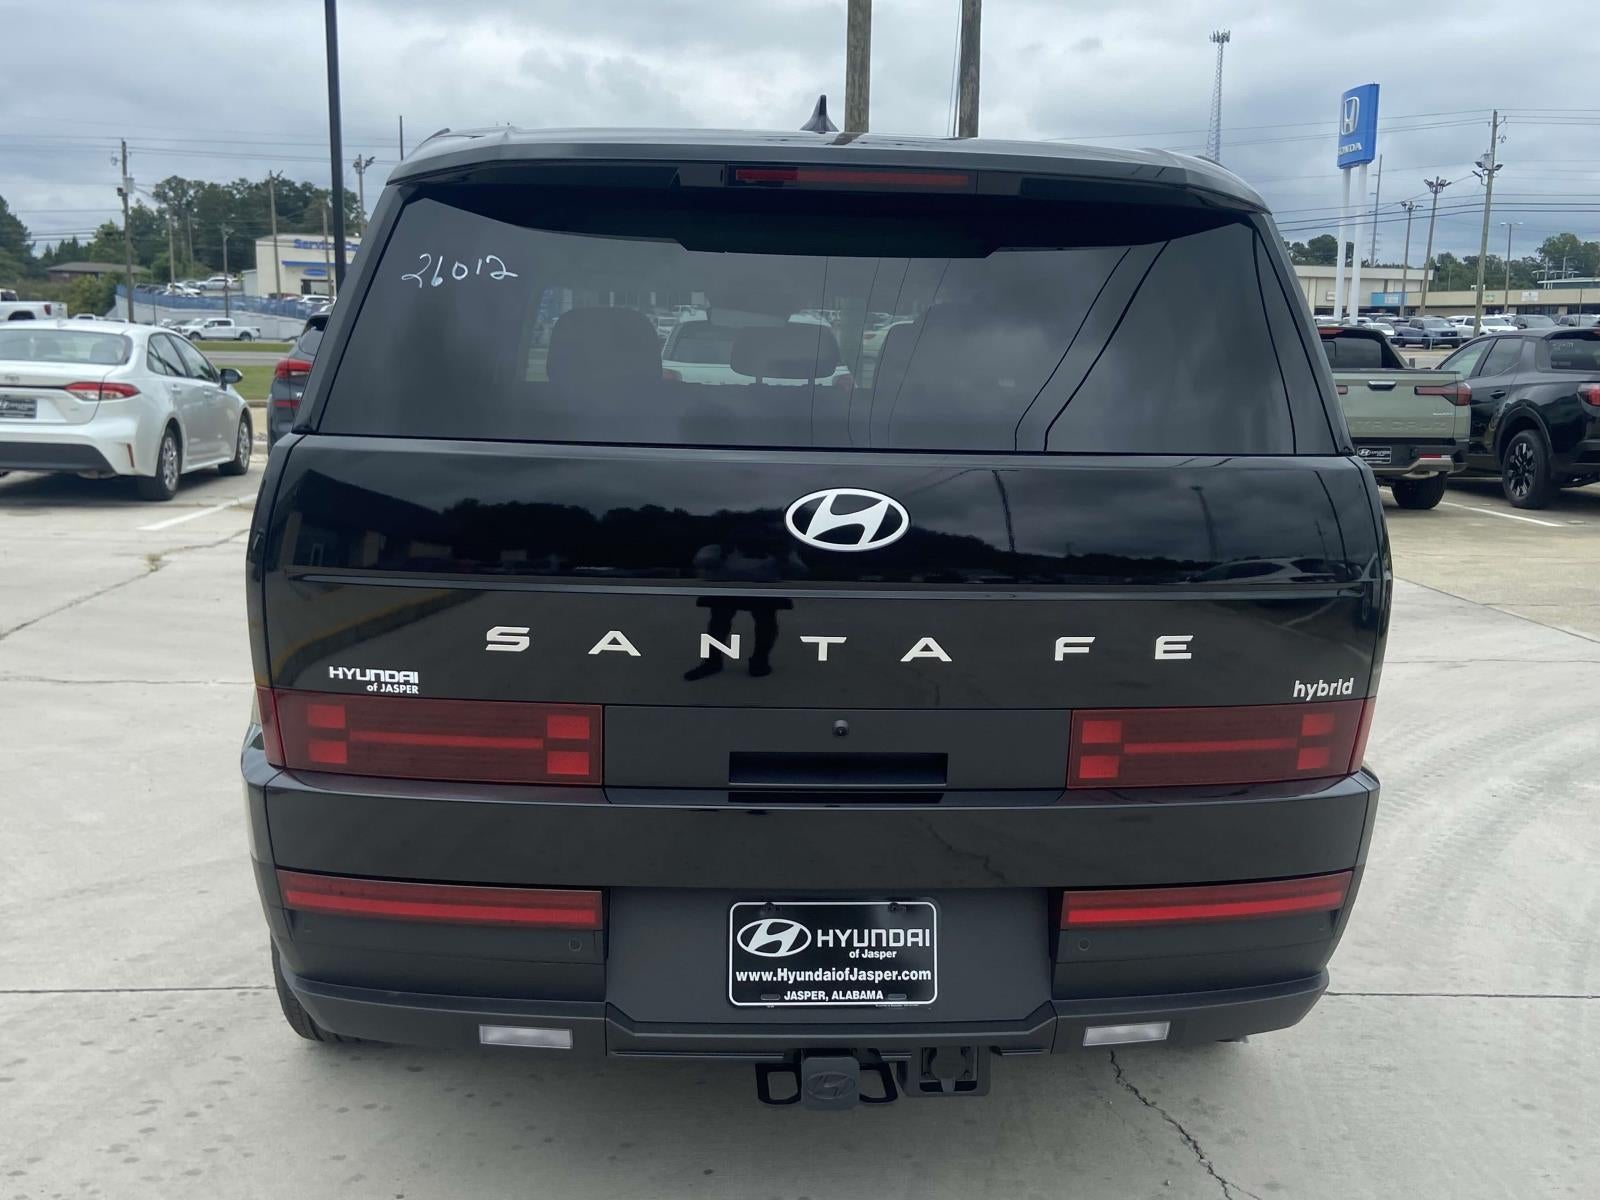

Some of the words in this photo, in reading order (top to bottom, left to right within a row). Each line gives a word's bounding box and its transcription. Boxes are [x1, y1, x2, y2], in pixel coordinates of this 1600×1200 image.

[401, 253, 519, 289] 26012
[485, 626, 953, 662] SANTA
[1054, 635, 1194, 662] FE
[328, 666, 419, 684] HYUNDAI
[366, 682, 378, 692] of
[380, 683, 419, 694] JASPER
[1293, 677, 1355, 701] hybrid
[817, 928, 931, 948] HYUNDAI
[848, 949, 859, 959] of
[861, 948, 898, 960] Jasper
[735, 967, 932, 984] www.HyundaiofJasper.com
[783, 990, 829, 1001] JASPER,
[831, 990, 884, 1000] ALABAMA
